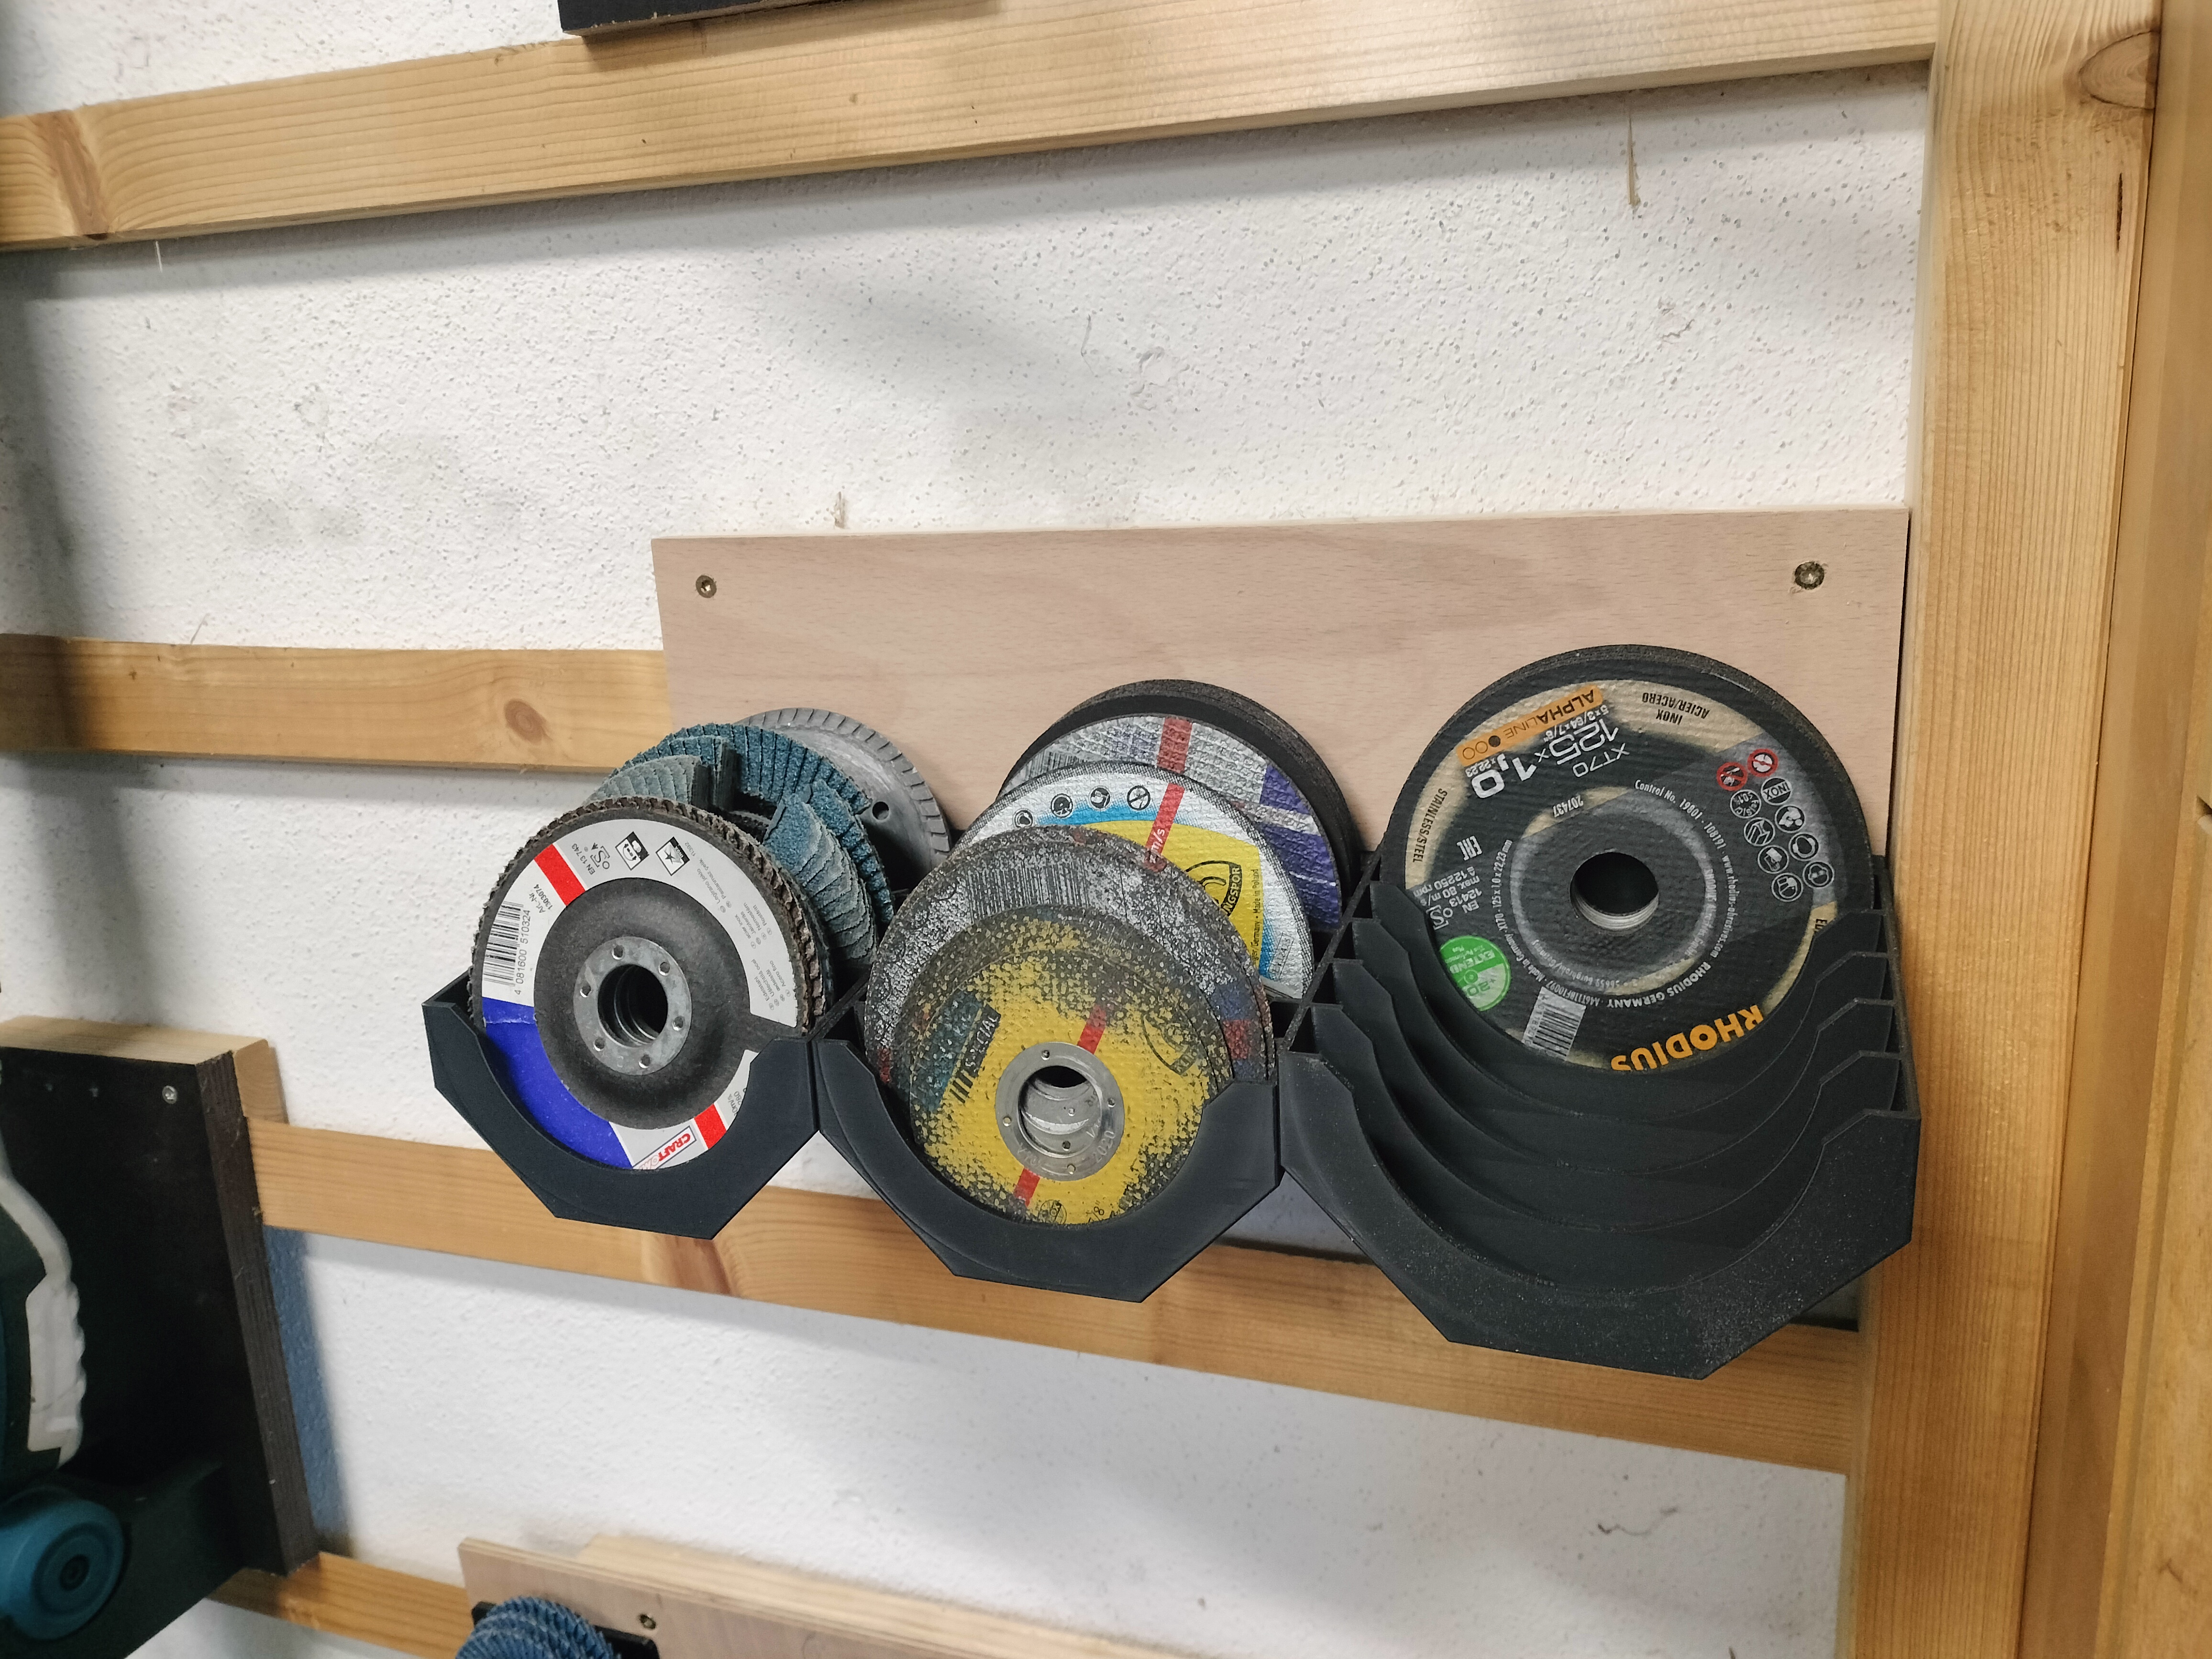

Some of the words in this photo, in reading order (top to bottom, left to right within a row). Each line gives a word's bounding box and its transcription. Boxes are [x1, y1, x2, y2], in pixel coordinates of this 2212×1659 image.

[1503, 689, 1594, 739] ALPHALINE
[1641, 692, 1710, 719] ACIER/ACERO
[1656, 709, 1683, 725] INOX
[1572, 743, 1630, 778] XT70
[1763, 782, 1791, 799] INOX
[1552, 795, 1584, 818] 207437
[1635, 779, 1666, 796] Control
[1664, 790, 1676, 804] No.
[1679, 798, 1703, 820] 19801
[1703, 822, 1727, 850] 108191
[1412, 788, 1448, 863] STAINLESS/STEEL
[586, 864, 596, 875] EN
[1250, 868, 1259, 889] Poland
[1433, 870, 1468, 887] 12250
[1413, 884, 1434, 898] rpm
[1457, 875, 1480, 890] max.
[534, 884, 553, 910] 1303074
[1420, 893, 1441, 907] m/s
[1442, 886, 1458, 899] 80
[1449, 887, 1482, 908] 12413
[1252, 897, 1261, 915] Made
[1461, 899, 1480, 914] EN
[520, 909, 531, 945] 510324
[734, 914, 743, 927] inox
[1494, 913, 1508, 931] XT70
[1505, 933, 1525, 962] Germany
[515, 949, 528, 984] 081600
[751, 959, 760, 971] ocel
[1522, 959, 1531, 968] in
[775, 976, 786, 987] Acero
[1528, 965, 1546, 982] Made
[1667, 961, 1712, 997] RHODIUS
[754, 976, 770, 1001] Edelstahl
[1606, 992, 1666, 1008] GERMANY
[1610, 1005, 1764, 1071] RHODIUS
[638, 1133, 691, 1170] CRAFTOM
